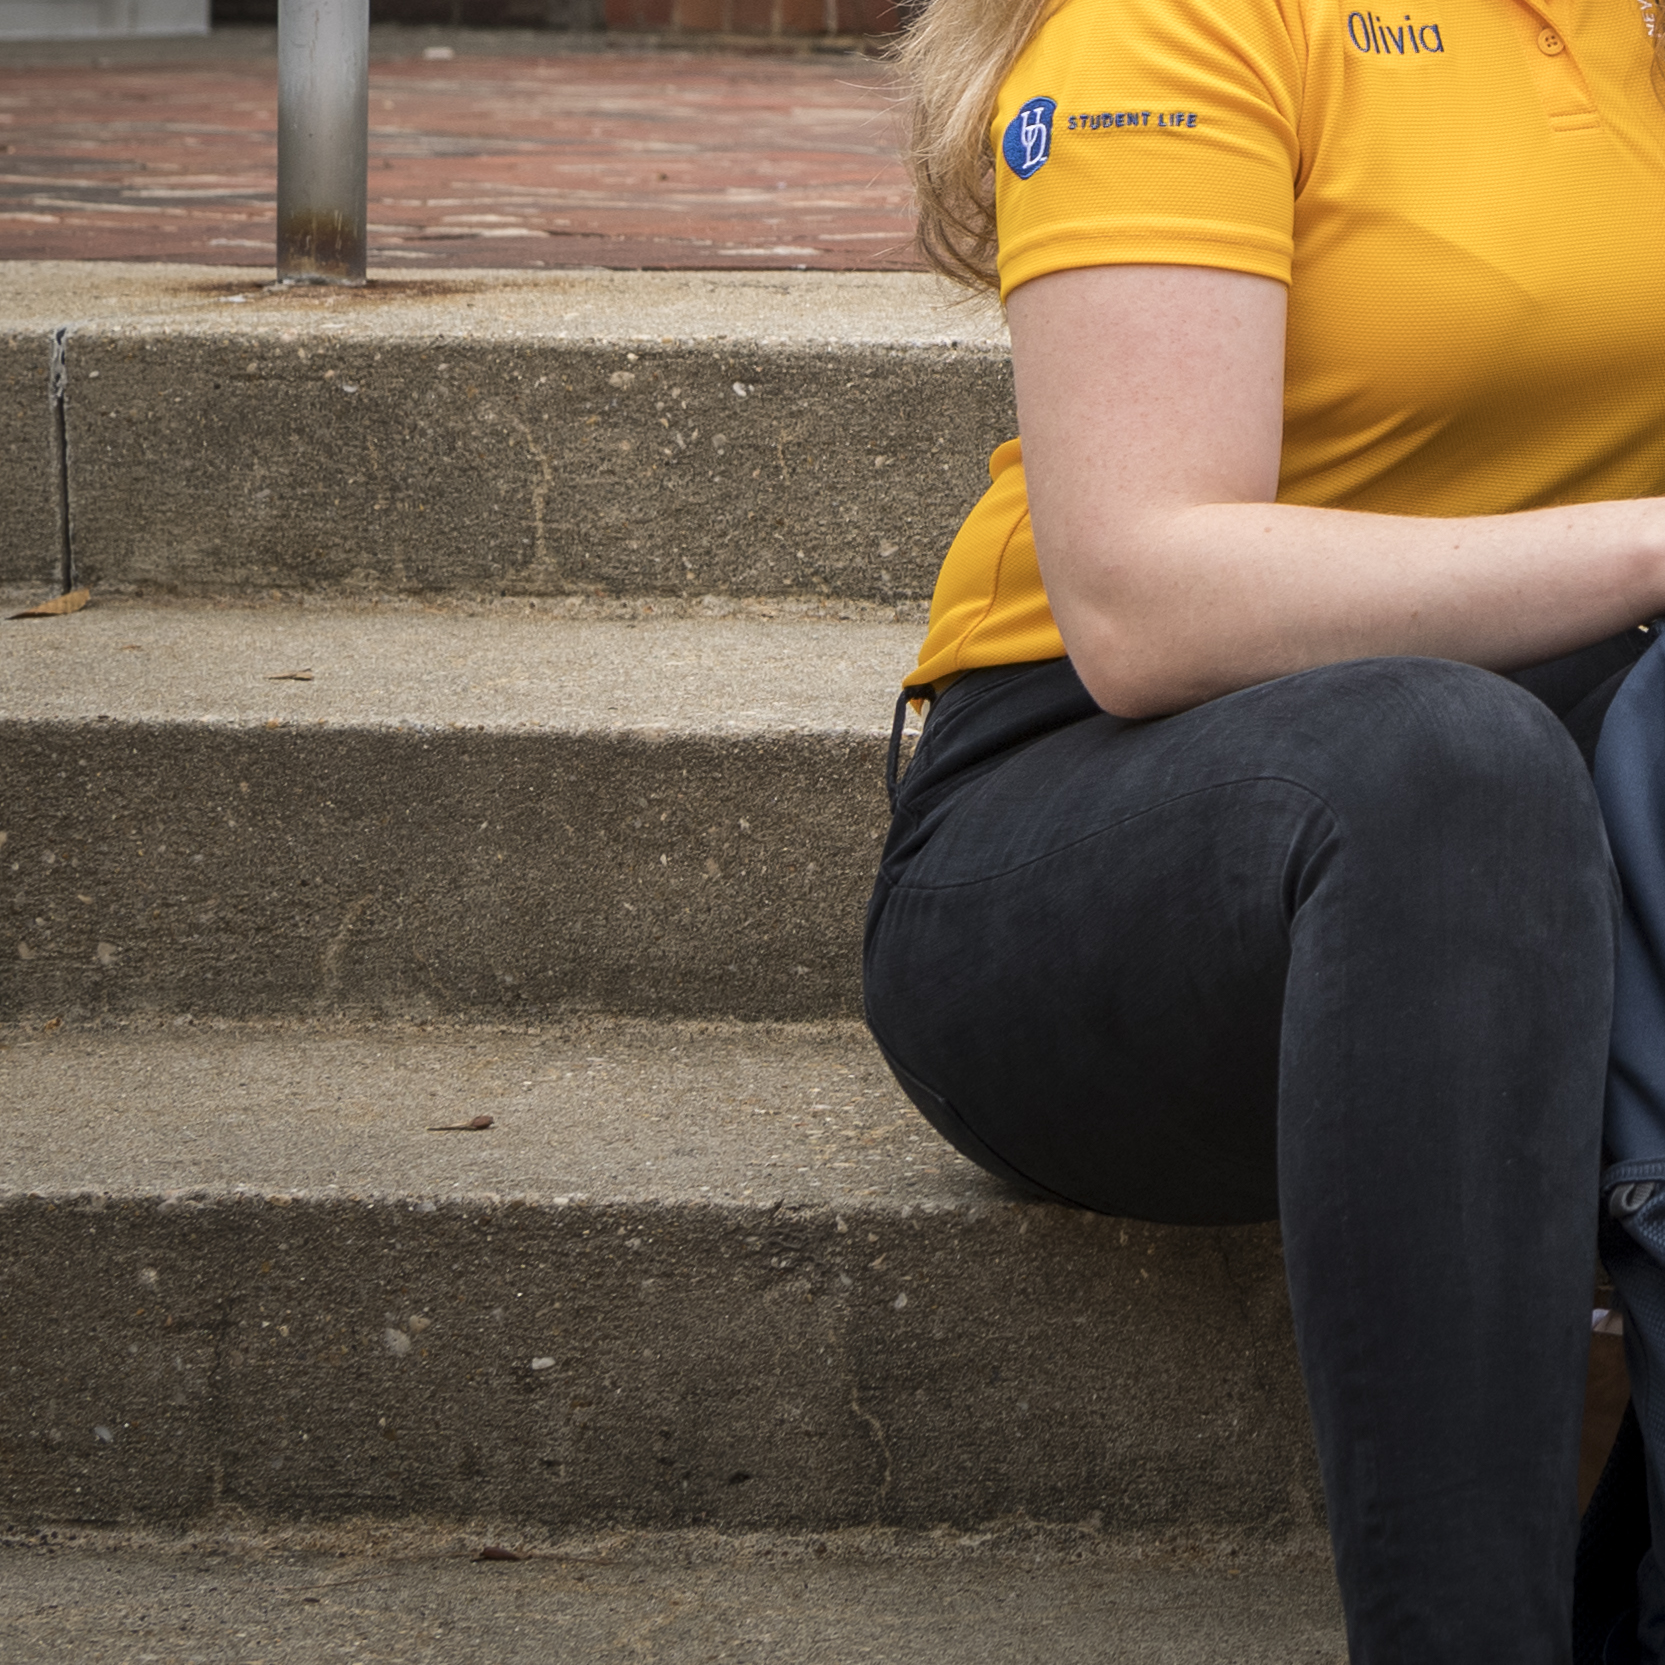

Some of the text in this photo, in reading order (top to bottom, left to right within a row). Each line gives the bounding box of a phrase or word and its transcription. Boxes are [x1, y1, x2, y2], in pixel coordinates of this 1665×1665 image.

[1348, 11, 1444, 54] Olivia
[1067, 112, 1198, 130] STUDENT LIFE
